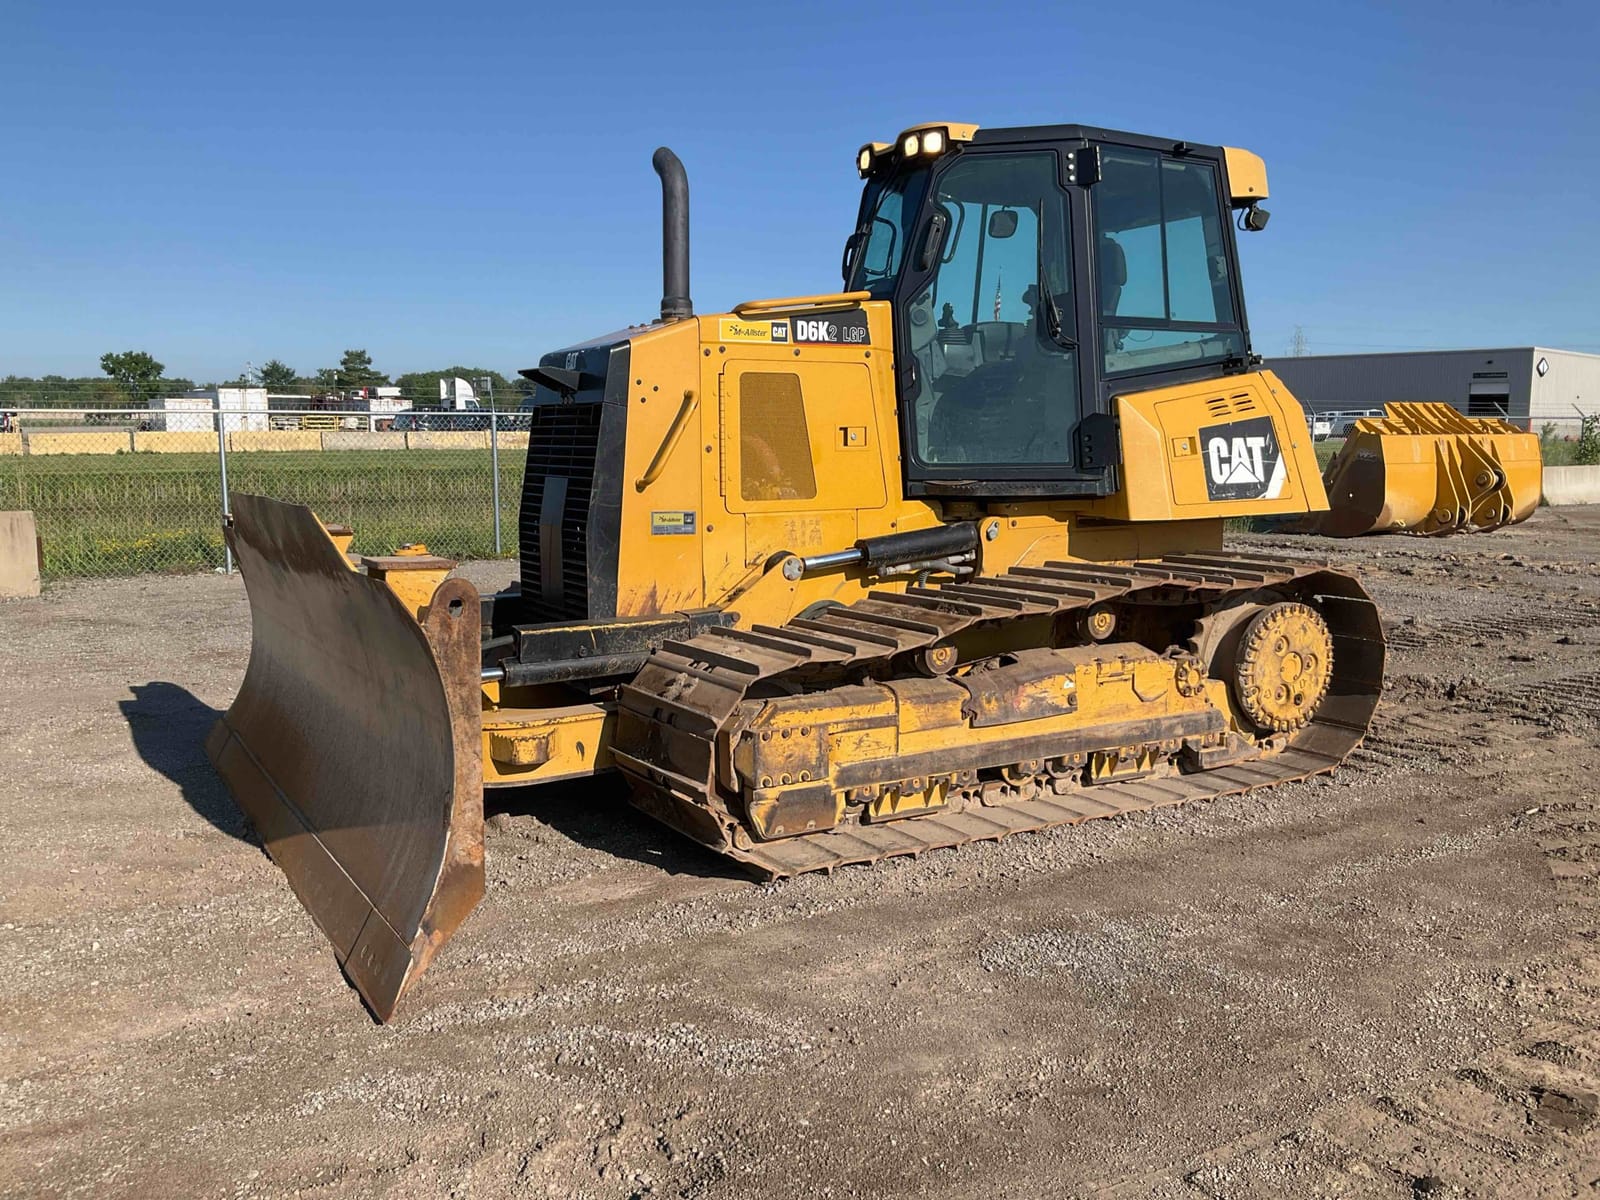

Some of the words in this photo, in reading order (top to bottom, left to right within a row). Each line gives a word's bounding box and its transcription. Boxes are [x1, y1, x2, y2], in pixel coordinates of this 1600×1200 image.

[772, 326, 787, 338] CAT
[796, 320, 837, 342] D6K2
[842, 327, 866, 342] LGP
[1208, 436, 1265, 485] CAT
